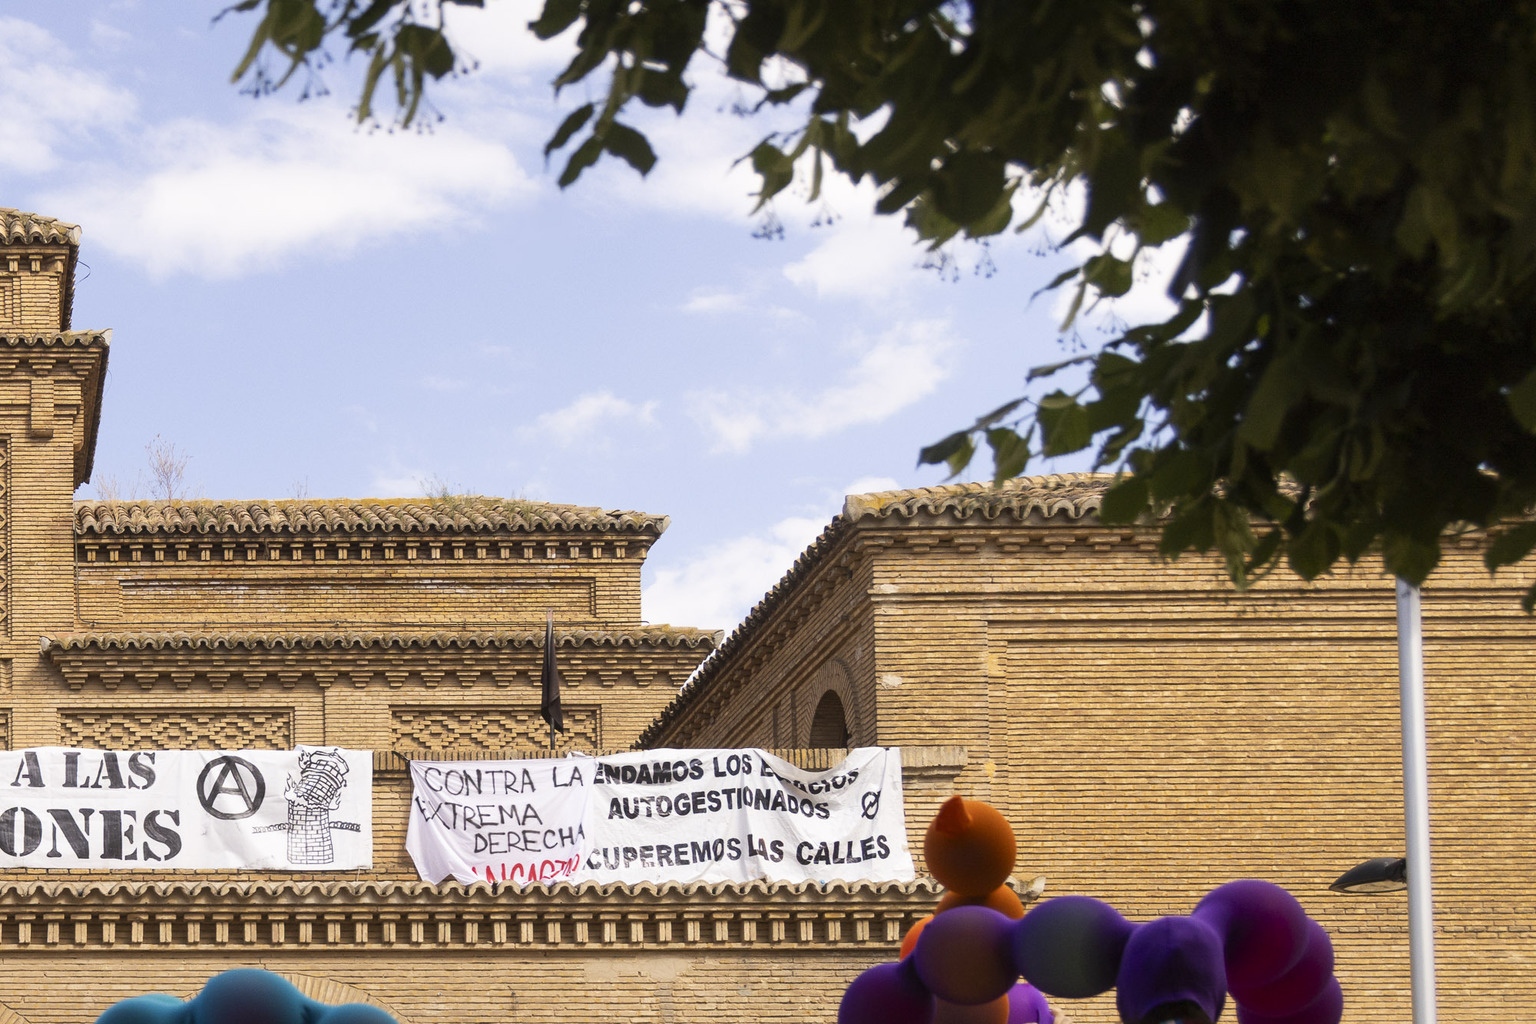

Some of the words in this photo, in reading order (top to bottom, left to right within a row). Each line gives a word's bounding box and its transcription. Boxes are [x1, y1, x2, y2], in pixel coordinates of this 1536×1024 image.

[11, 751, 46, 788] A
[62, 751, 156, 790] LAS
[425, 767, 536, 796] CONTRA
[552, 766, 584, 788] LA
[594, 758, 704, 785] ENDAMOS
[713, 753, 752, 778] LOS
[415, 795, 543, 831] EXTREMA
[608, 786, 830, 820] AUTOGESTIONADOS
[474, 822, 586, 855] DERECHA
[583, 837, 742, 870] CUPEREMOS
[747, 833, 784, 863] LAS
[796, 834, 891, 865] CALLES
